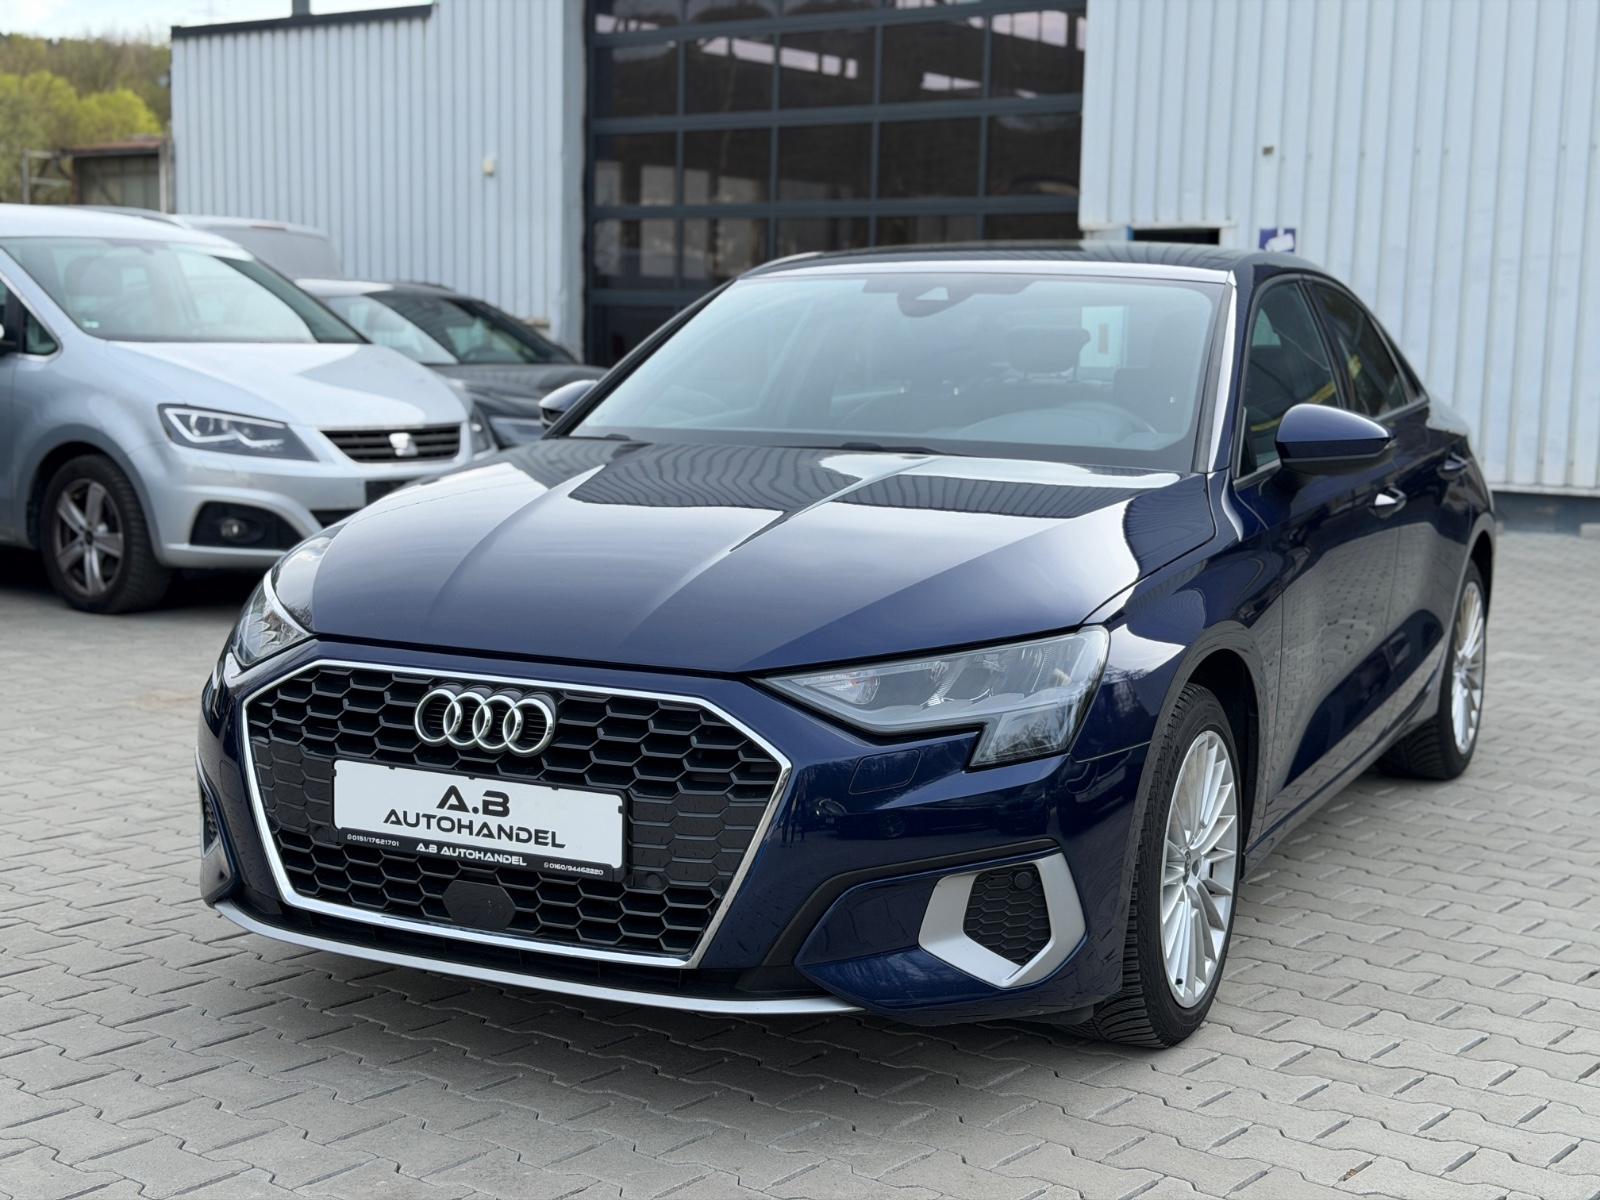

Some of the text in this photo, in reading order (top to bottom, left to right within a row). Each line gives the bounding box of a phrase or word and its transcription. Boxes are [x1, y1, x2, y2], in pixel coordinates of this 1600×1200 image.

[436, 785, 510, 817] A.B
[383, 808, 566, 849] AUTOHANDEL
[416, 842, 527, 866] A.B AUTOHANDEL
